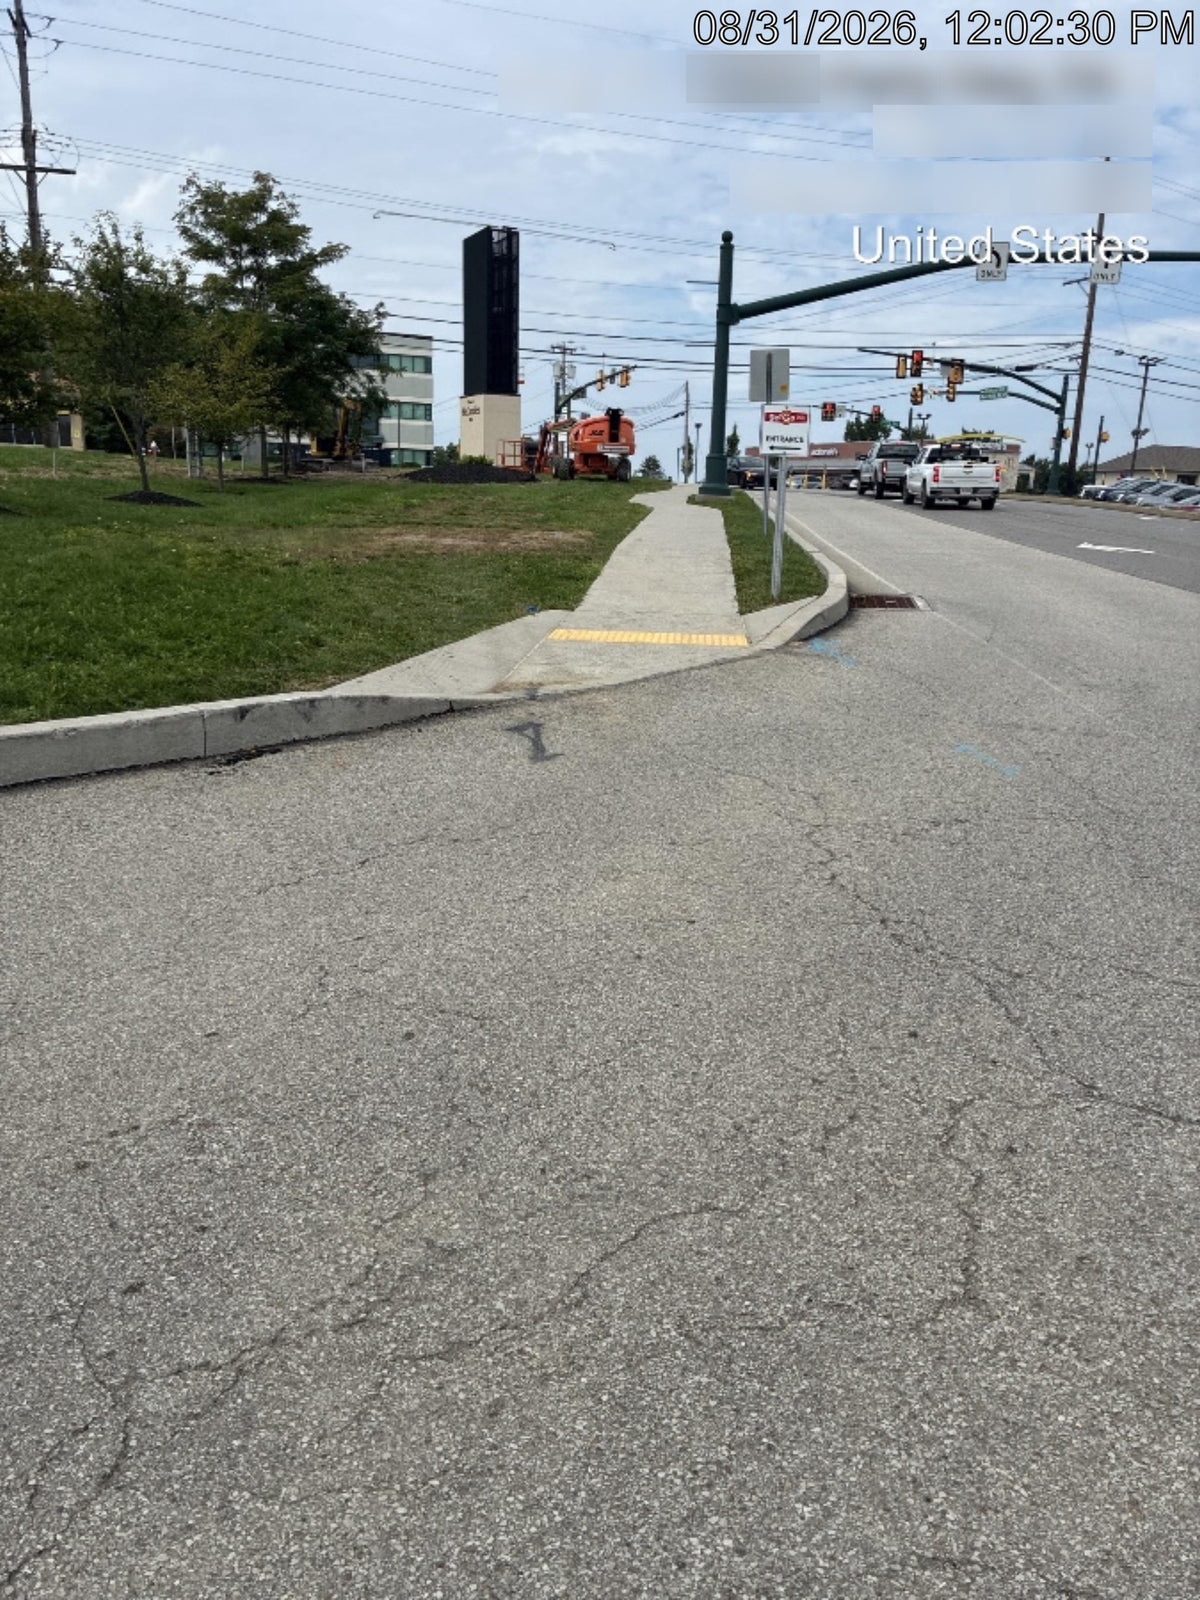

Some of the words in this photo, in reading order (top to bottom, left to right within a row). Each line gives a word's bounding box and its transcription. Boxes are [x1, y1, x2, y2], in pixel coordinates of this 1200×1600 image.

[980, 269, 1003, 279] ONLY
[1093, 272, 1116, 282] ONLY
[765, 434, 804, 443] ENTRANCE
